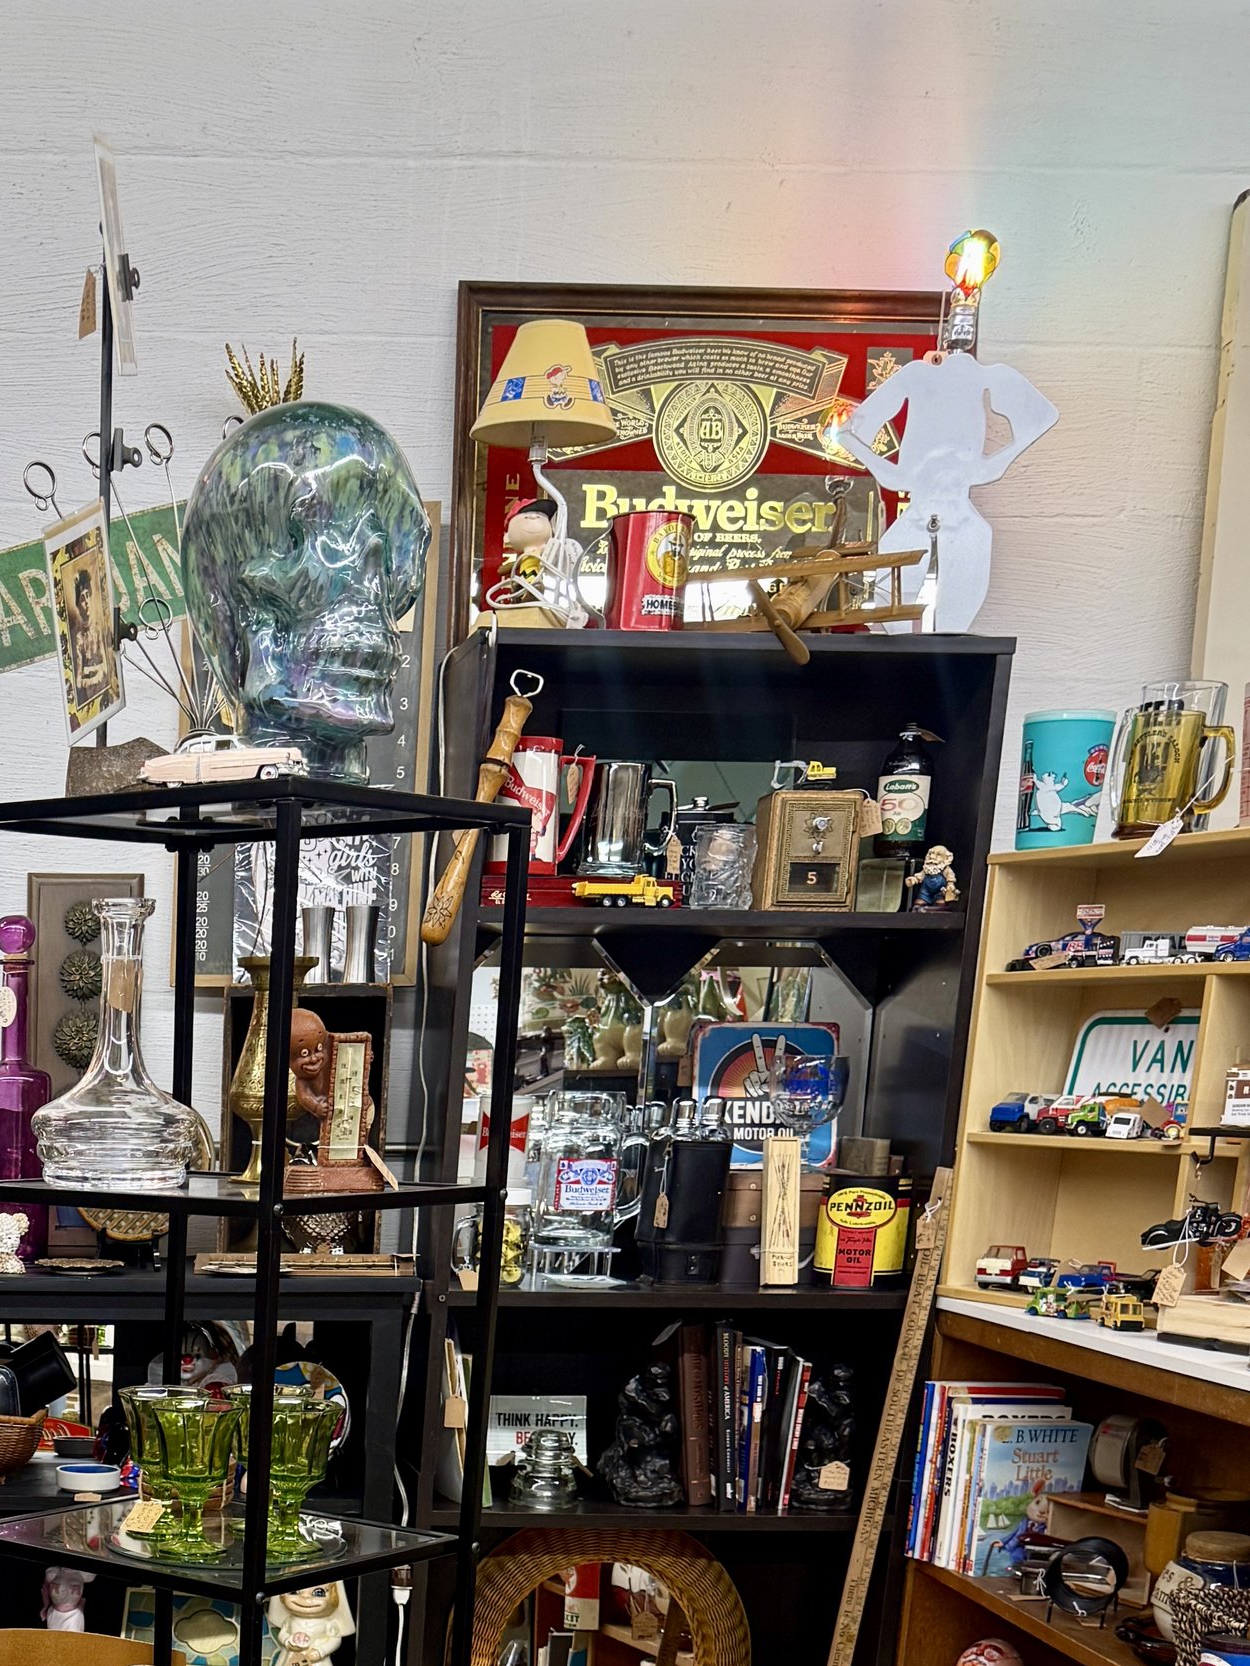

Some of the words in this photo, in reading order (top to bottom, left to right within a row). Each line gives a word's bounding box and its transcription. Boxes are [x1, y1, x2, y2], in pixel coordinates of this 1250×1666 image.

[693, 532, 710, 544] OF
[713, 532, 762, 545] BEERS.
[400, 655, 410, 668] 2
[399, 698, 409, 710] 3
[397, 737, 406, 748] 4
[396, 767, 405, 778] 5
[885, 781, 918, 792] Labatt's
[881, 797, 920, 812] 50
[393, 837, 402, 849] 7
[328, 845, 376, 875] girls
[351, 869, 377, 884] WITH
[391, 863, 400, 876] 8
[806, 872, 817, 885] 5
[1131, 1039, 1195, 1073] VAN
[733, 1127, 774, 1140] MOTOR
[564, 1184, 610, 1195] Budweiser
[829, 1199, 896, 1212] PENNZOIL
[838, 1249, 872, 1257] MOTOR
[846, 1256, 862, 1264] OIL
[910, 1272, 927, 1305] HEAT
[897, 1310, 919, 1366] COUNCIL
[722, 1390, 730, 1420] AMERICA
[495, 1413, 531, 1427] THINK
[535, 1413, 579, 1428] HAPPY.
[871, 1386, 902, 1483] SOUTHEASTERN
[1016, 1429, 1027, 1443] B.
[1028, 1428, 1079, 1443] WHITE
[1011, 1447, 1060, 1464] Stuart
[944, 1432, 958, 1497] BOXERS
[1015, 1465, 1054, 1482] Little
[857, 1485, 880, 1545] MICHIGAN
[844, 1577, 860, 1607] There
